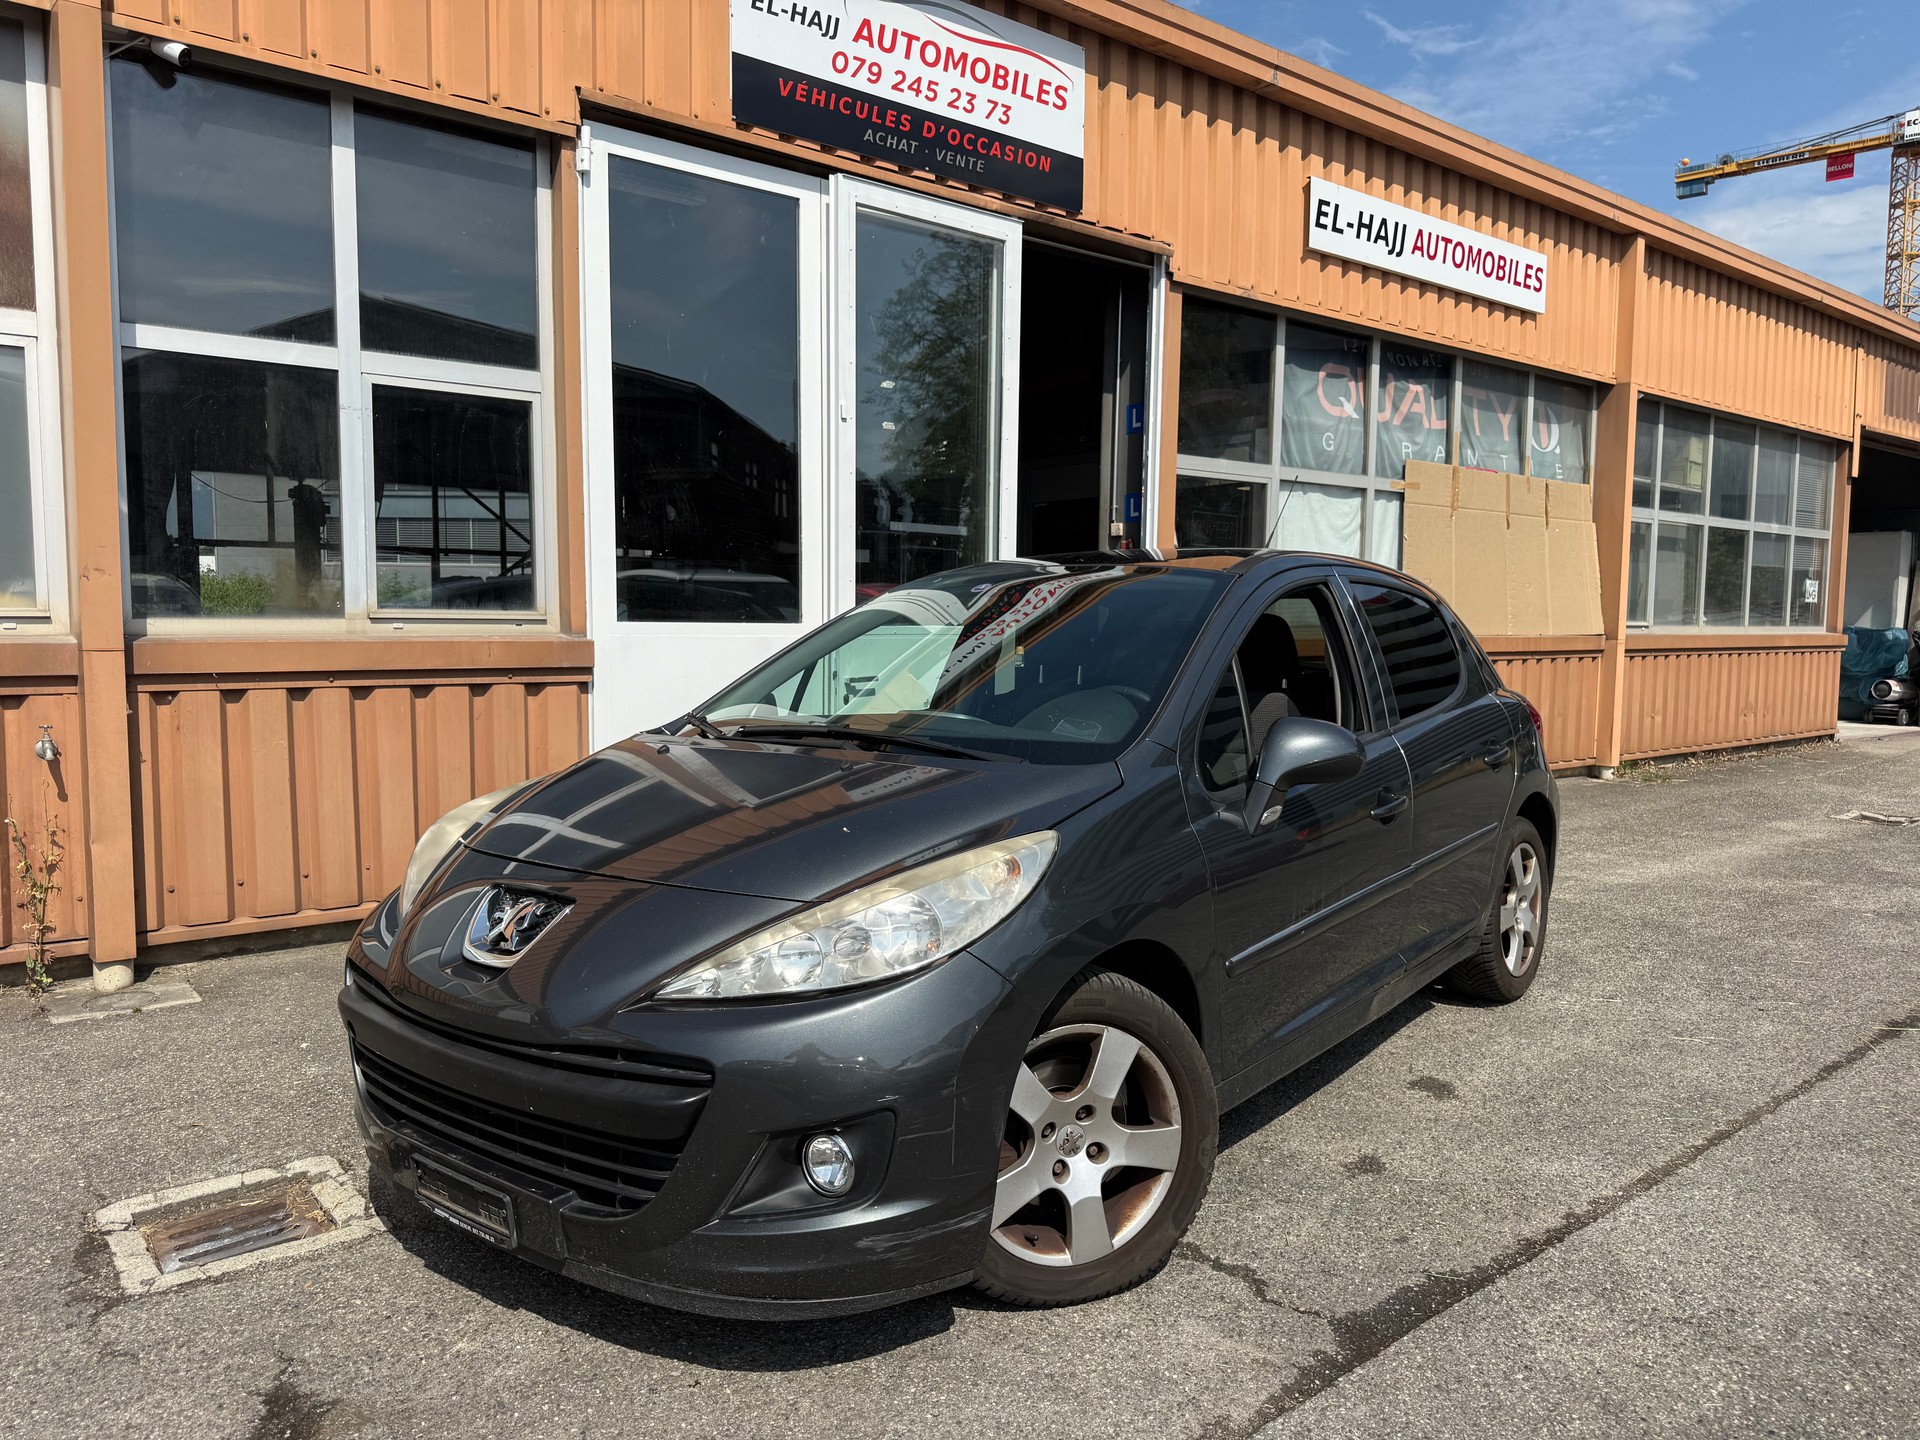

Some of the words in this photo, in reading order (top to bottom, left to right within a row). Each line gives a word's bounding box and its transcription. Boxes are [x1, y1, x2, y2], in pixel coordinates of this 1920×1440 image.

[751, 0, 840, 40] EL-HAJJ
[852, 17, 1068, 111] AUTOMOBILES
[778, 78, 912, 133] VÉHICULES
[831, 51, 882, 84] 079
[891, 70, 939, 102] 245
[947, 87, 977, 114] 23
[985, 99, 1012, 125] 73
[863, 129, 919, 154] ACHAT
[936, 148, 985, 173] VENTE
[1828, 163, 1853, 172] BELLONI
[1314, 198, 1407, 257] EL-HAJJ
[1411, 228, 1544, 293] AUTOMOBILES
[1132, 408, 1141, 428] L
[1317, 362, 1517, 442] QUALTY
[1322, 432, 1564, 479] GRANTIE
[1130, 498, 1139, 517] L
